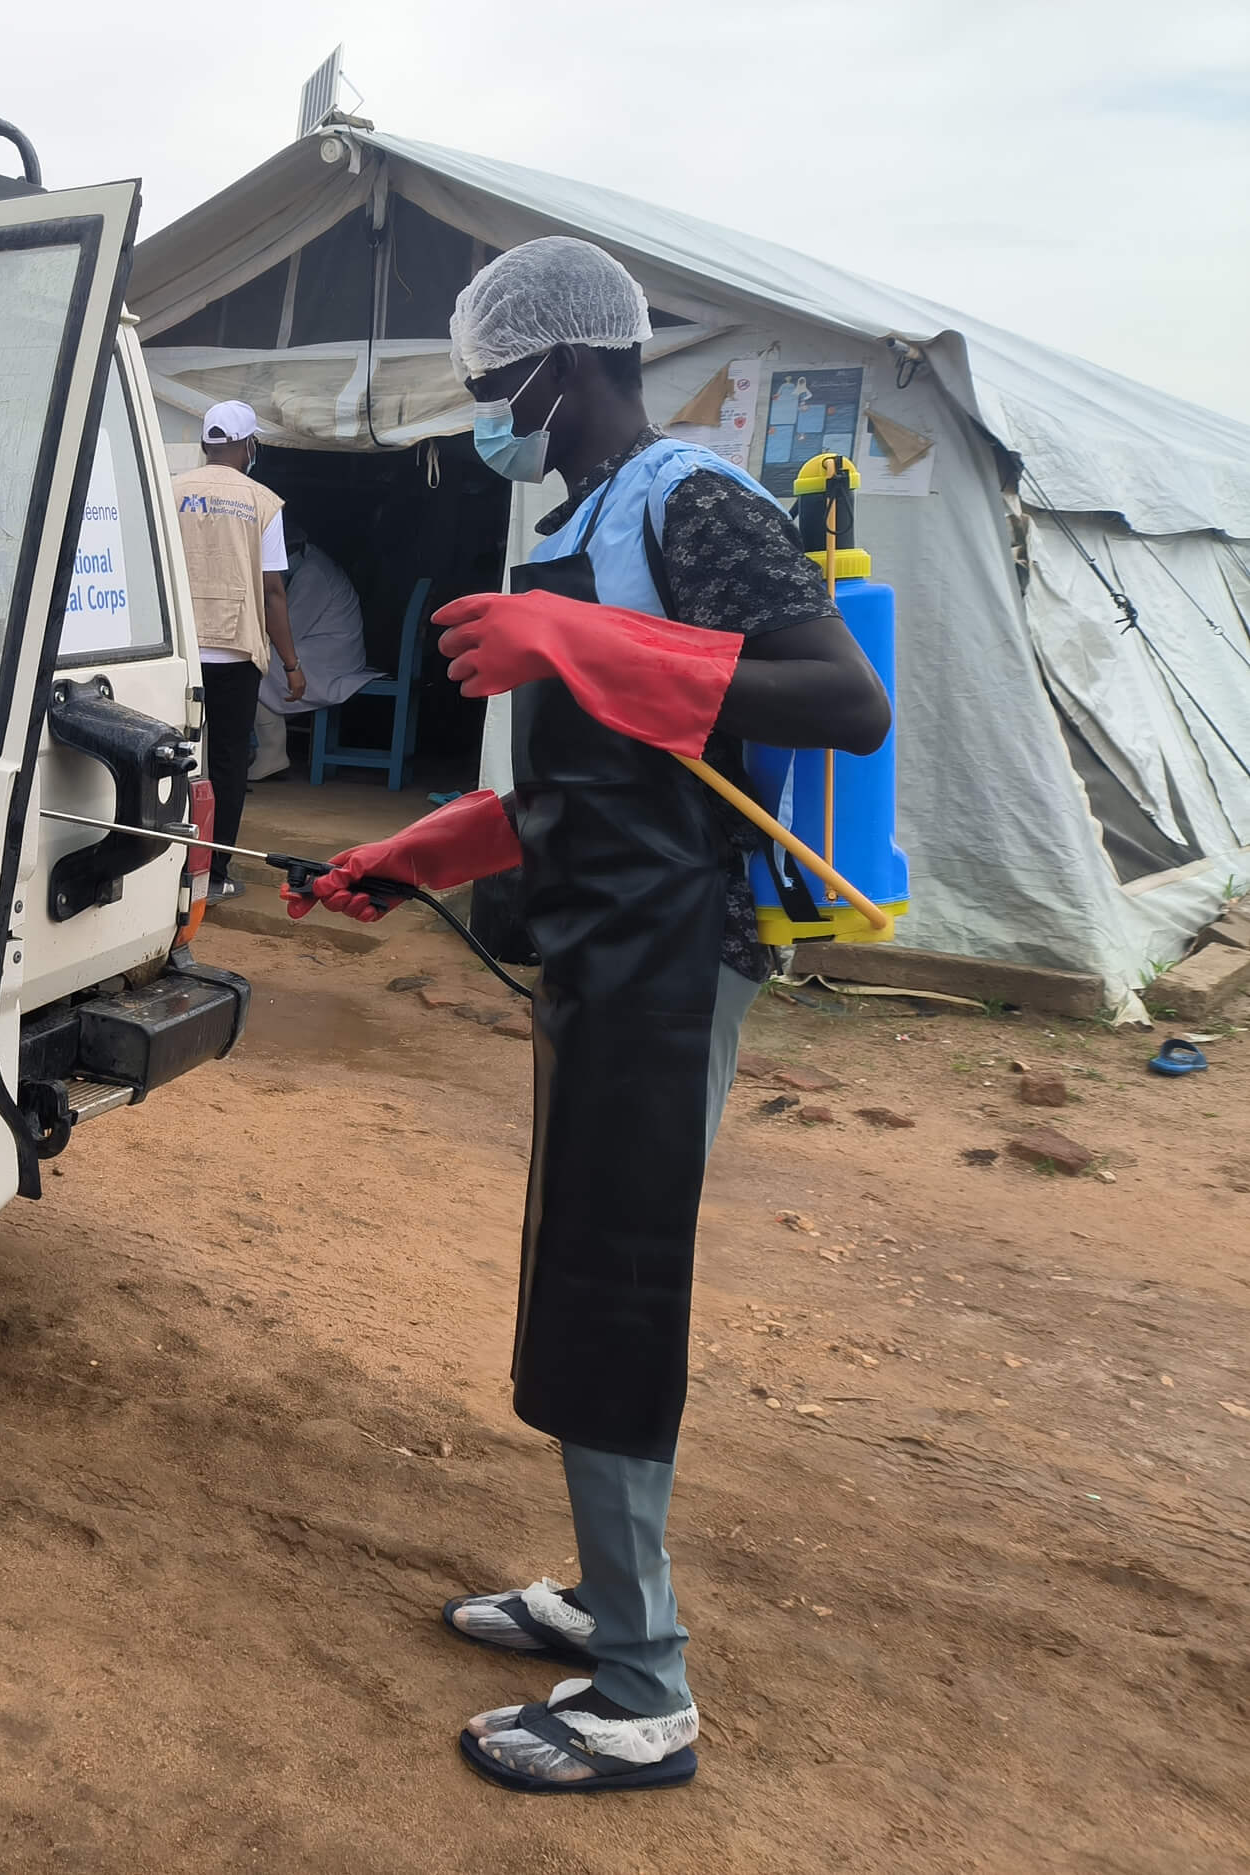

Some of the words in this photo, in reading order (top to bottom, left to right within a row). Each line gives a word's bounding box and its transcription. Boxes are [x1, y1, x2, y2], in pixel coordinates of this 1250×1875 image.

[84, 501, 118, 520] éenne
[210, 495, 255, 512] International
[73, 547, 113, 574] tional
[88, 585, 126, 615] Corps
